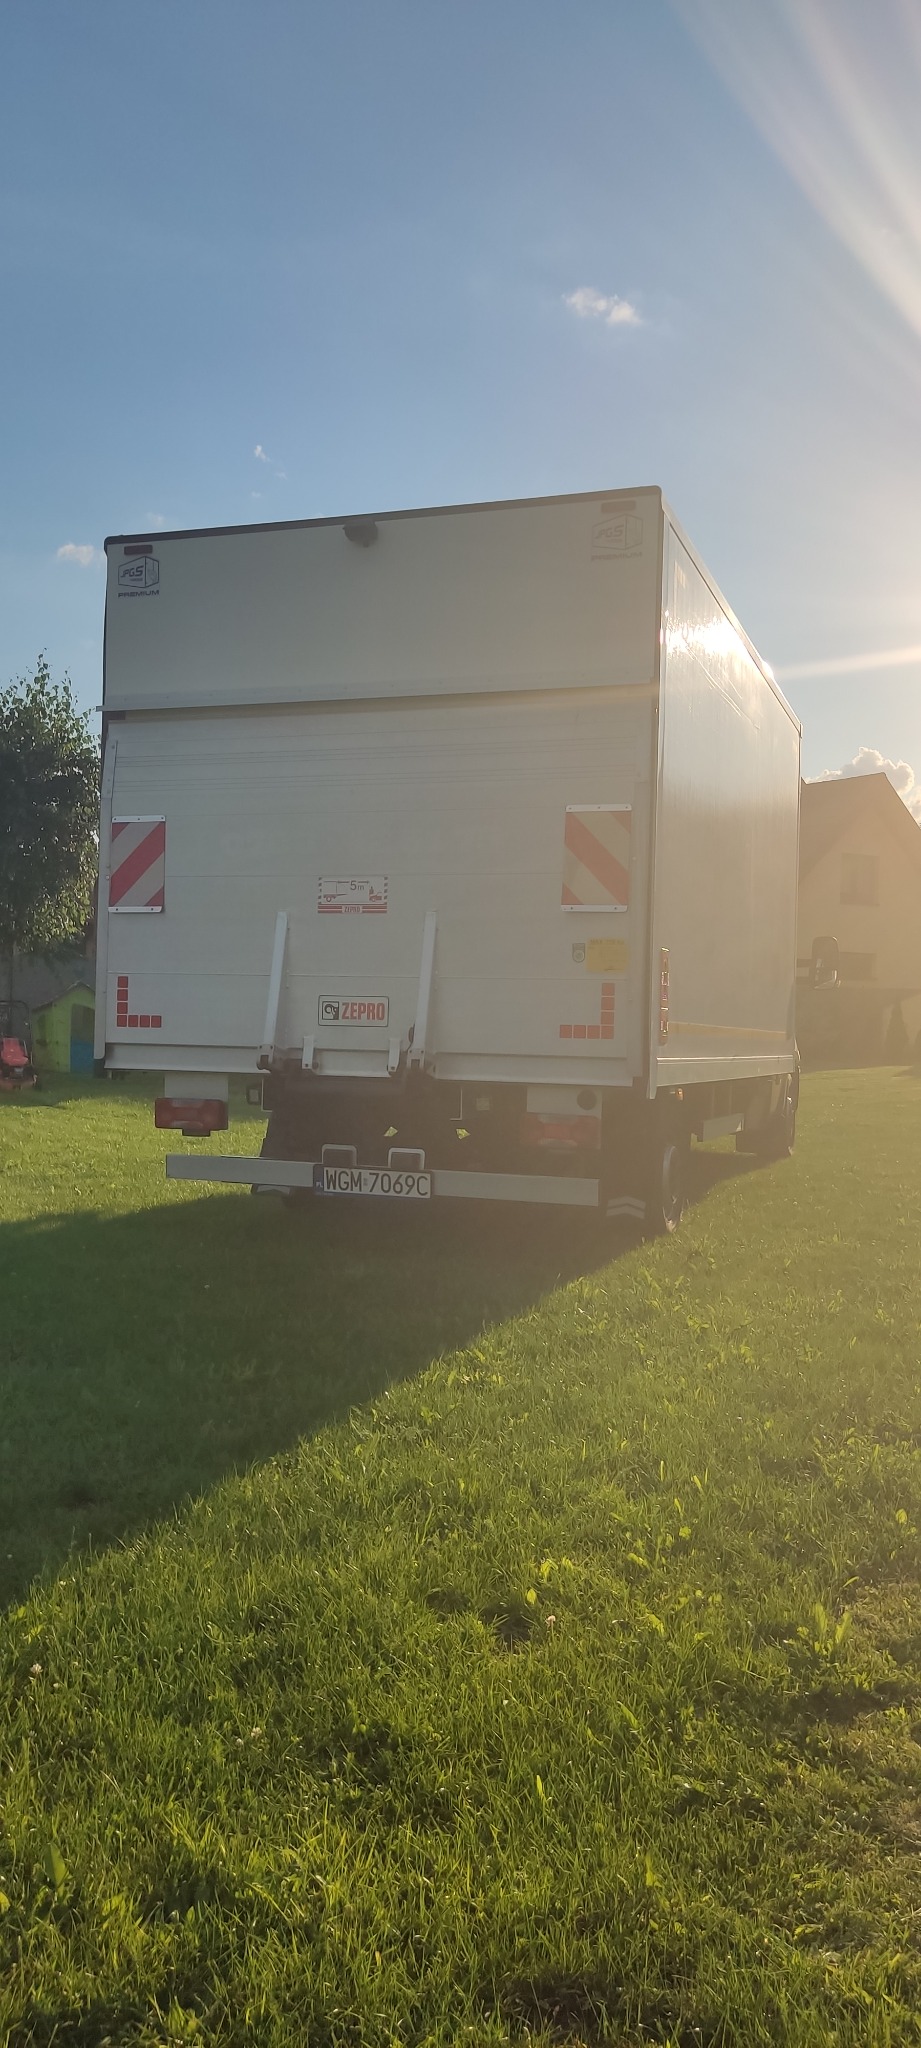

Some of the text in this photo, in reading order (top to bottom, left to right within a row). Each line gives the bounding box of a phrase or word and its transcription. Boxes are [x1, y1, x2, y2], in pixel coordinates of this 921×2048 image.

[341, 1002, 386, 1021] ZEPRO
[325, 1169, 428, 1196] WGM 7069C
